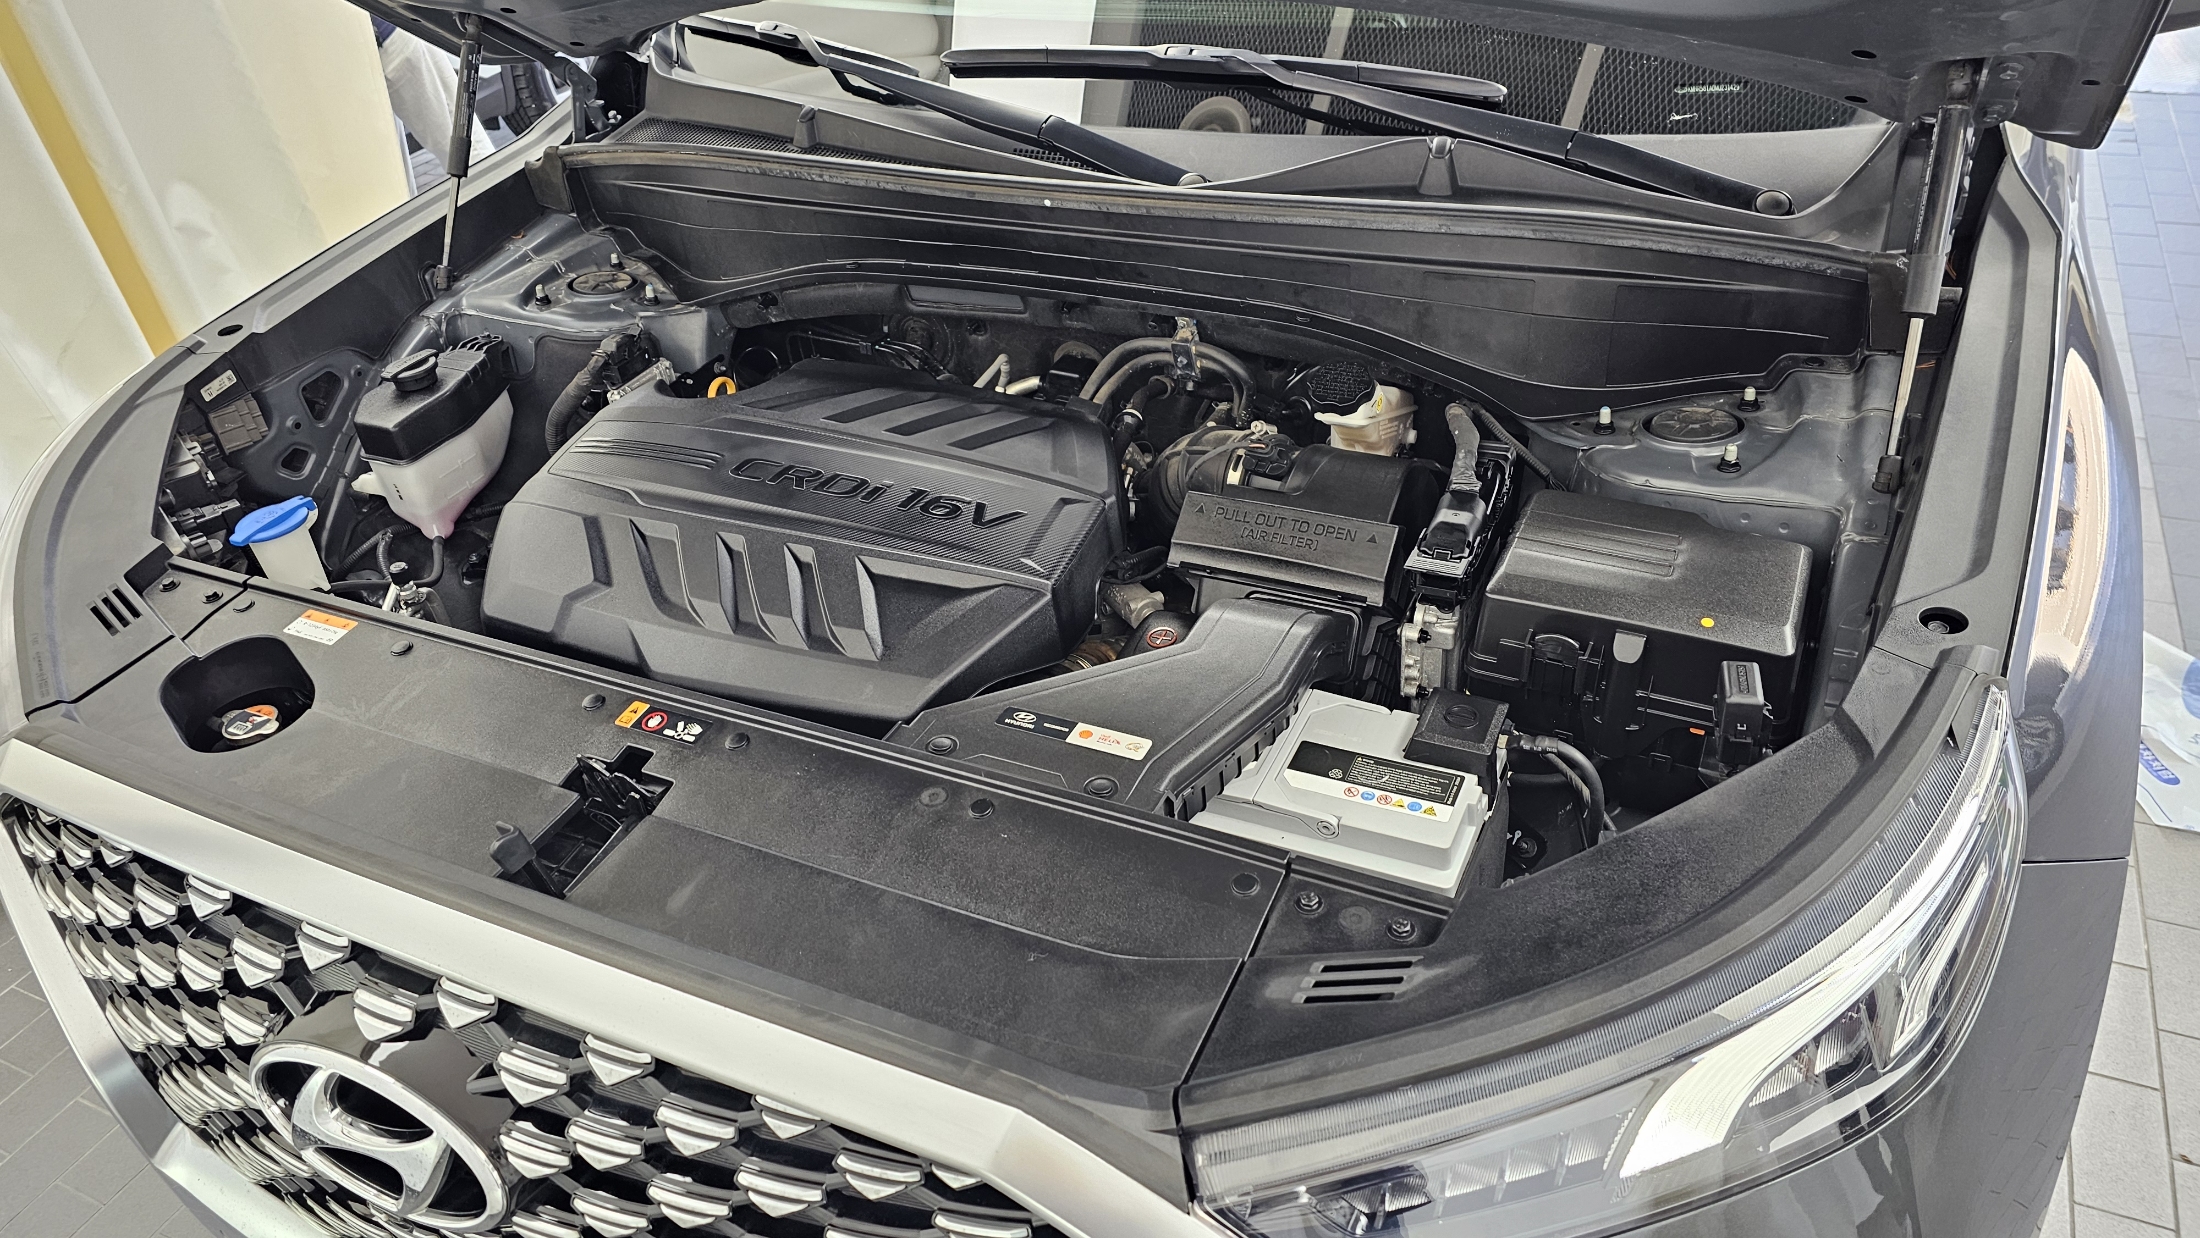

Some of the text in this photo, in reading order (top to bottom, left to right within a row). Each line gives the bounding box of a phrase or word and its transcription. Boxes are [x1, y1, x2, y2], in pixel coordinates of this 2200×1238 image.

[729, 457, 1028, 529] CRDi 16V
[1215, 506, 1357, 542] PULL OUT TO OPEN
